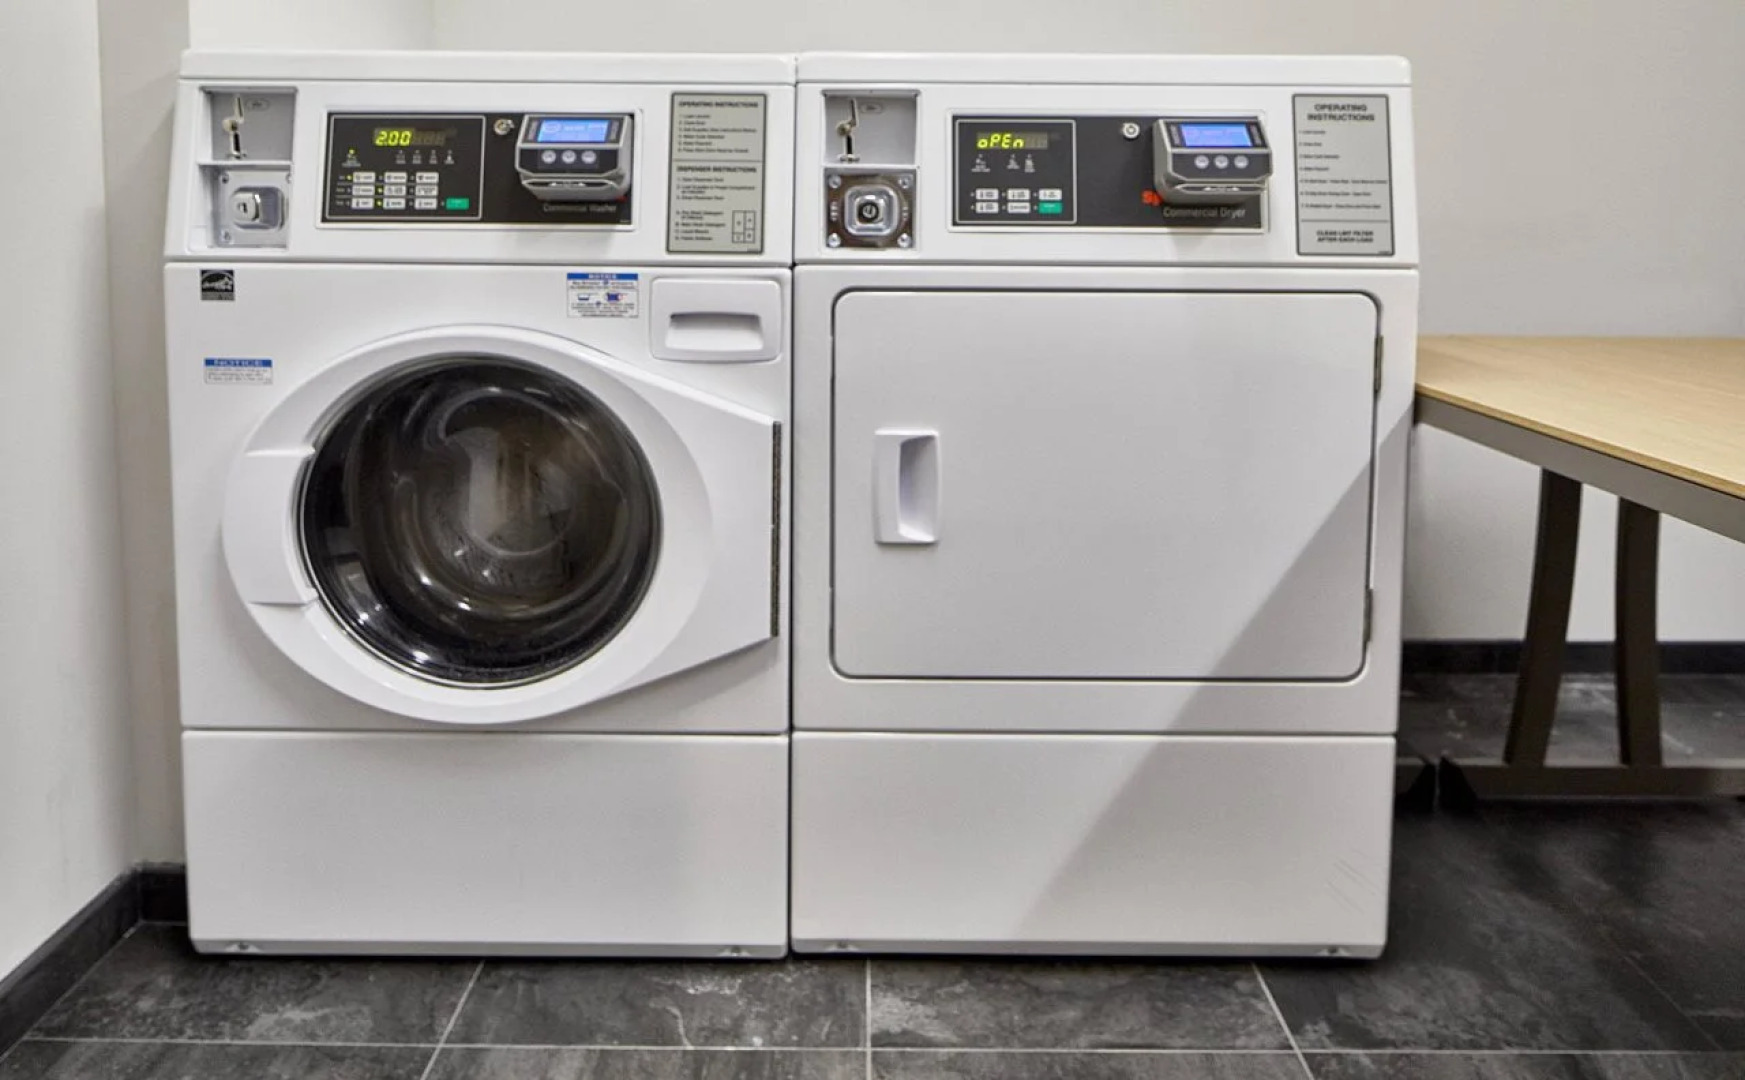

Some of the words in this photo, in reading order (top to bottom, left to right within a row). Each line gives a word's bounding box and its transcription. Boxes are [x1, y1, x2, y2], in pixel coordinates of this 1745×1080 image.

[1314, 104, 1367, 112] OPERATING
[1307, 113, 1375, 121] INSTRUCTIONS
[1163, 206, 1218, 218] Commercial
[1220, 206, 1246, 219] Dryer
